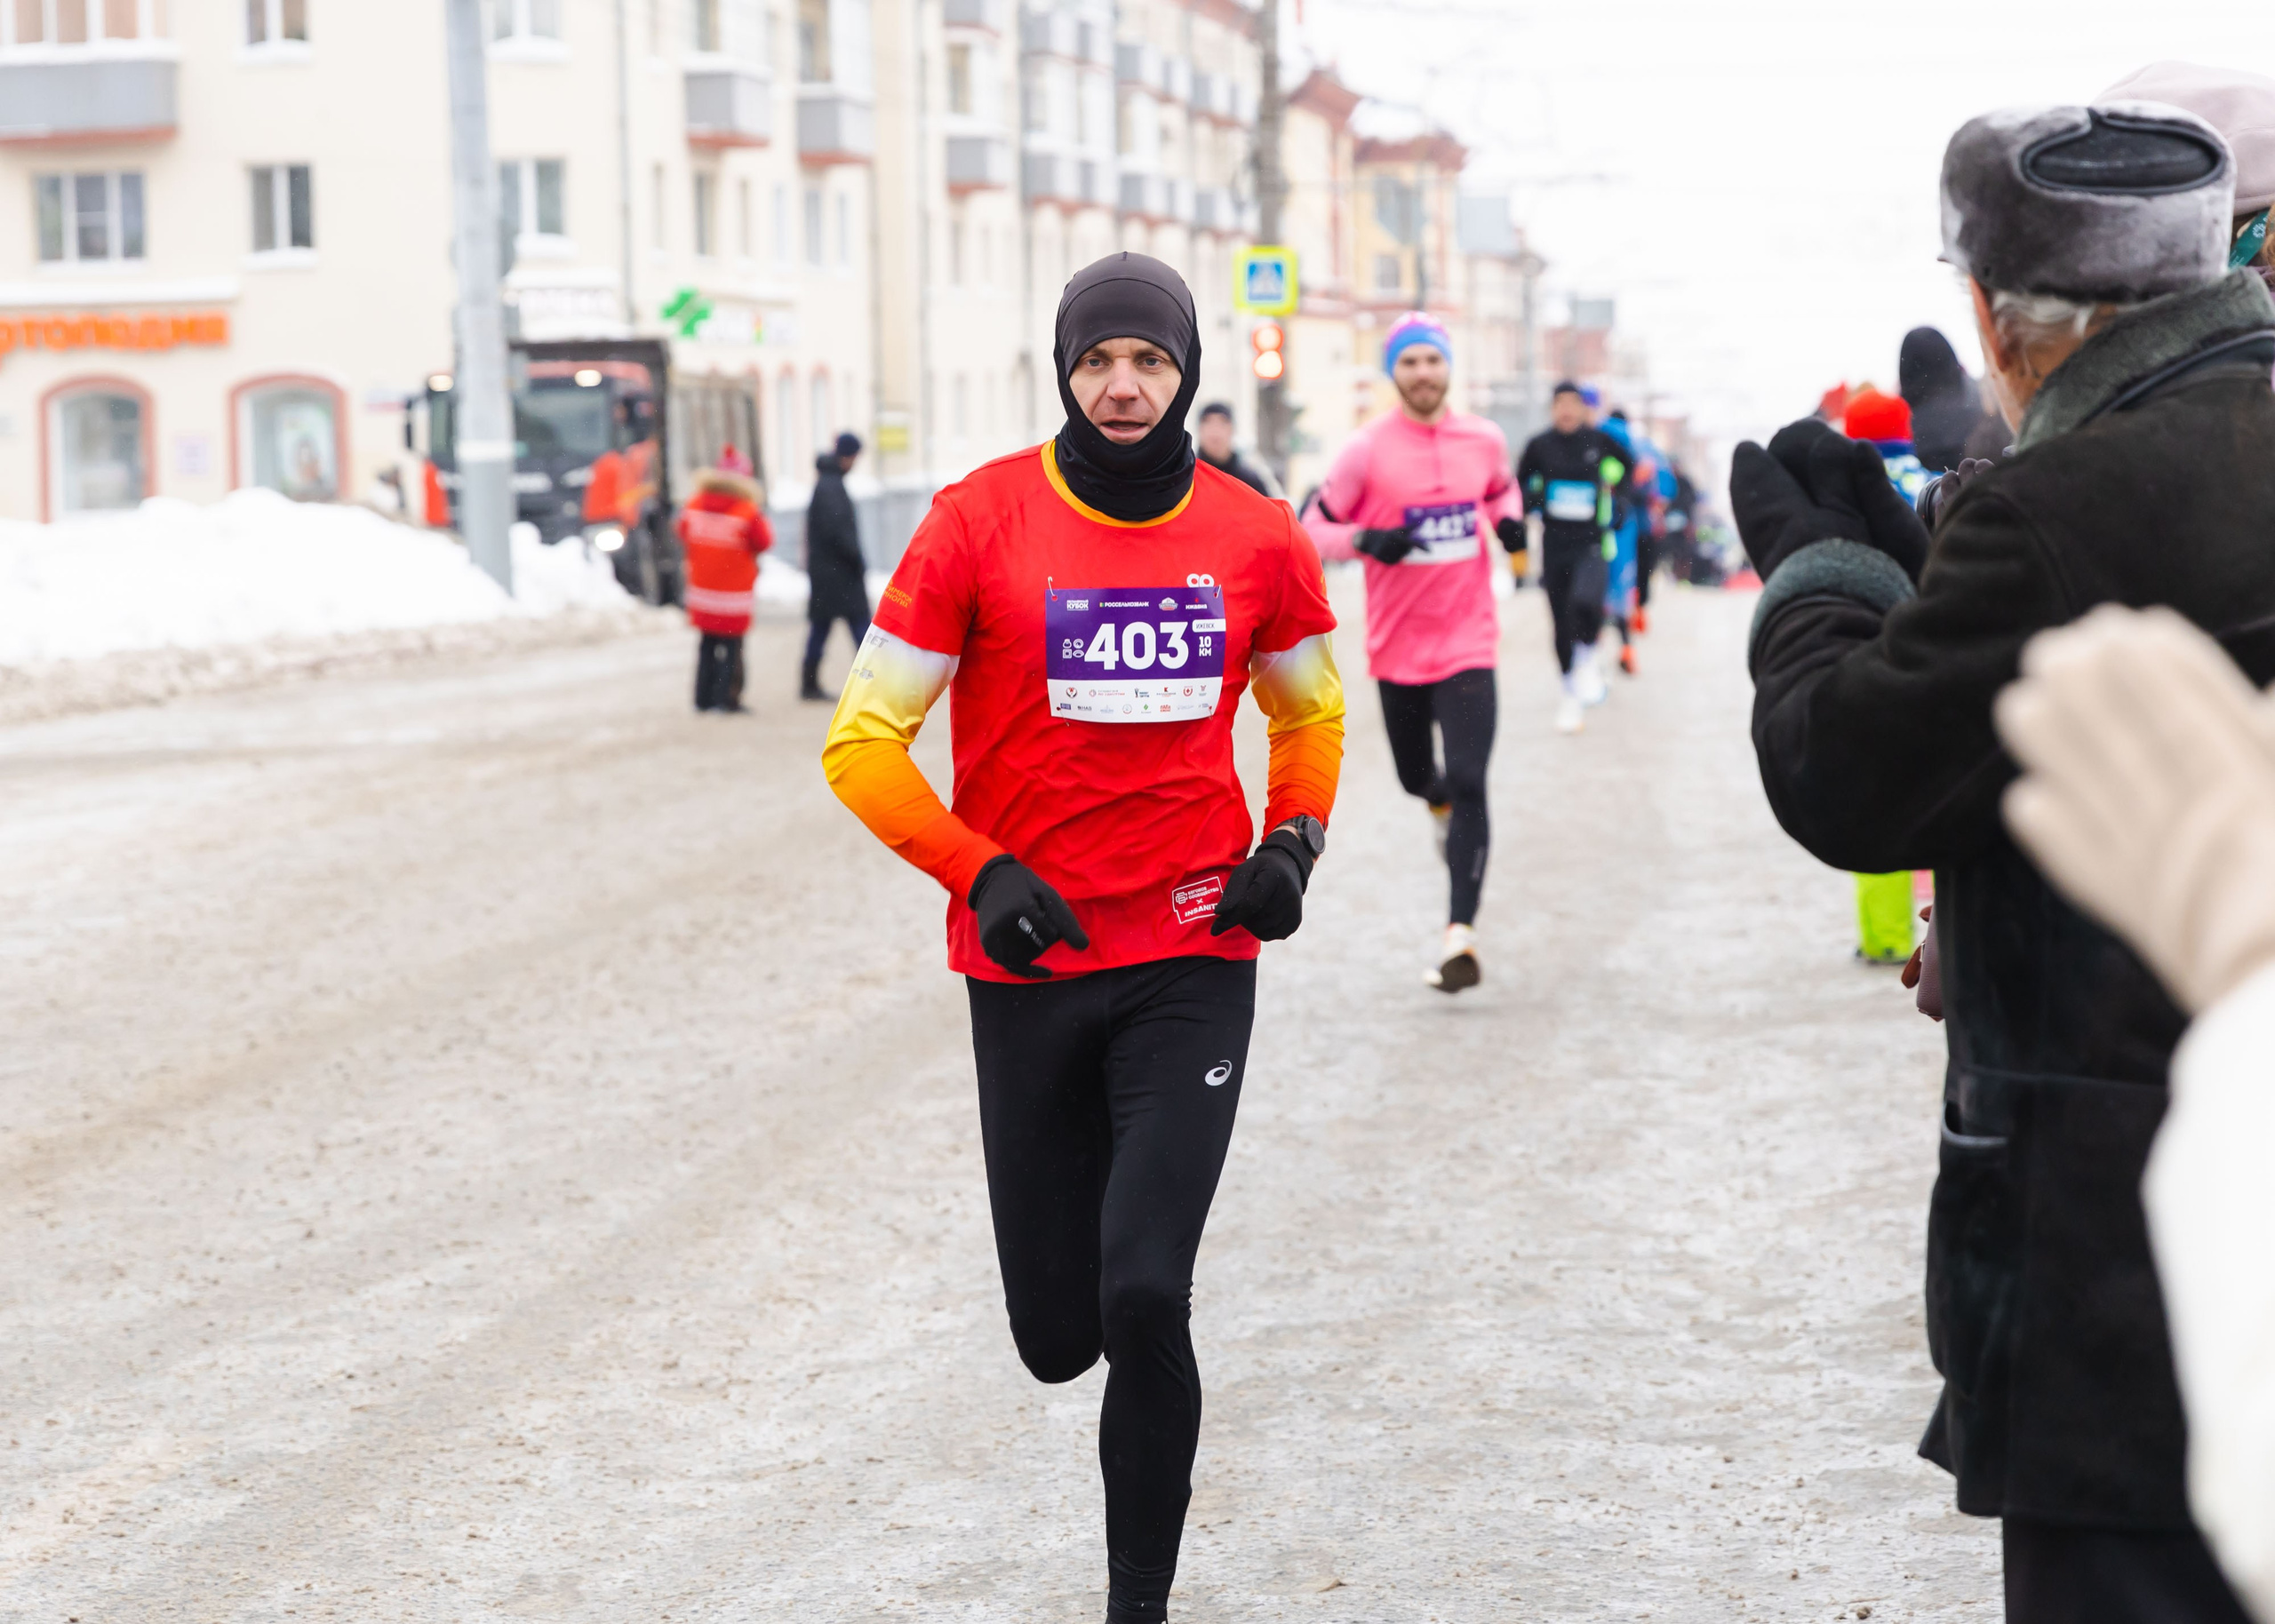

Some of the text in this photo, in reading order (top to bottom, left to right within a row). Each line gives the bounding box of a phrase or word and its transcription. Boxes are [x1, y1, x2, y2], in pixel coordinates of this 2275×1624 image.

[1084, 621, 1189, 670] 403
[1199, 636, 1212, 648] 10
[1185, 903, 1218, 917] INSANIT
